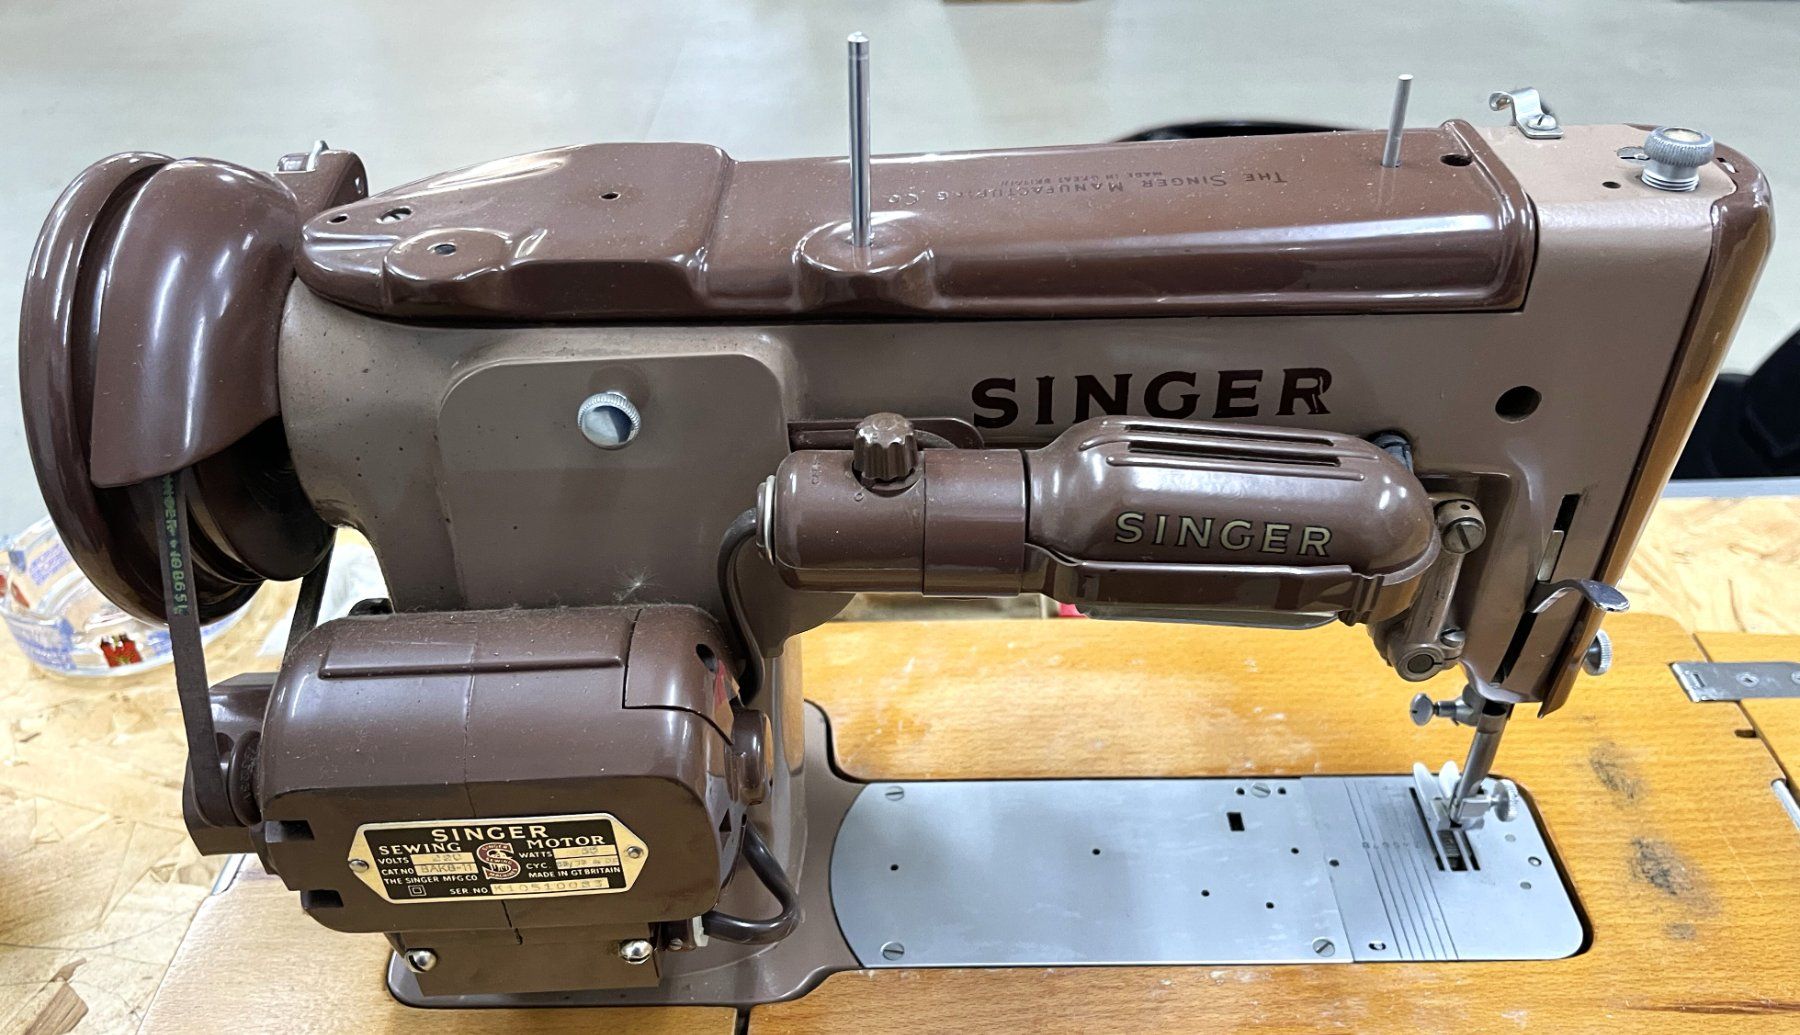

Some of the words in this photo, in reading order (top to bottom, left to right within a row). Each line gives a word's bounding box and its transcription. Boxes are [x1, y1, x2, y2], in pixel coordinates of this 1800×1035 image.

[1141, 174, 1227, 188] SINGER
[1242, 171, 1288, 184] THE
[971, 367, 1333, 429] SINGER
[1115, 510, 1333, 557] SINGER
[431, 825, 549, 842] SINGER
[378, 842, 463, 856] SEWING
[527, 835, 605, 850] MOTOR
[377, 857, 410, 865] VOLTS
[518, 851, 553, 859] WATTS
[400, 867, 415, 875] NO
[585, 867, 621, 875] BRITAIN
[405, 876, 440, 884] SINGER
